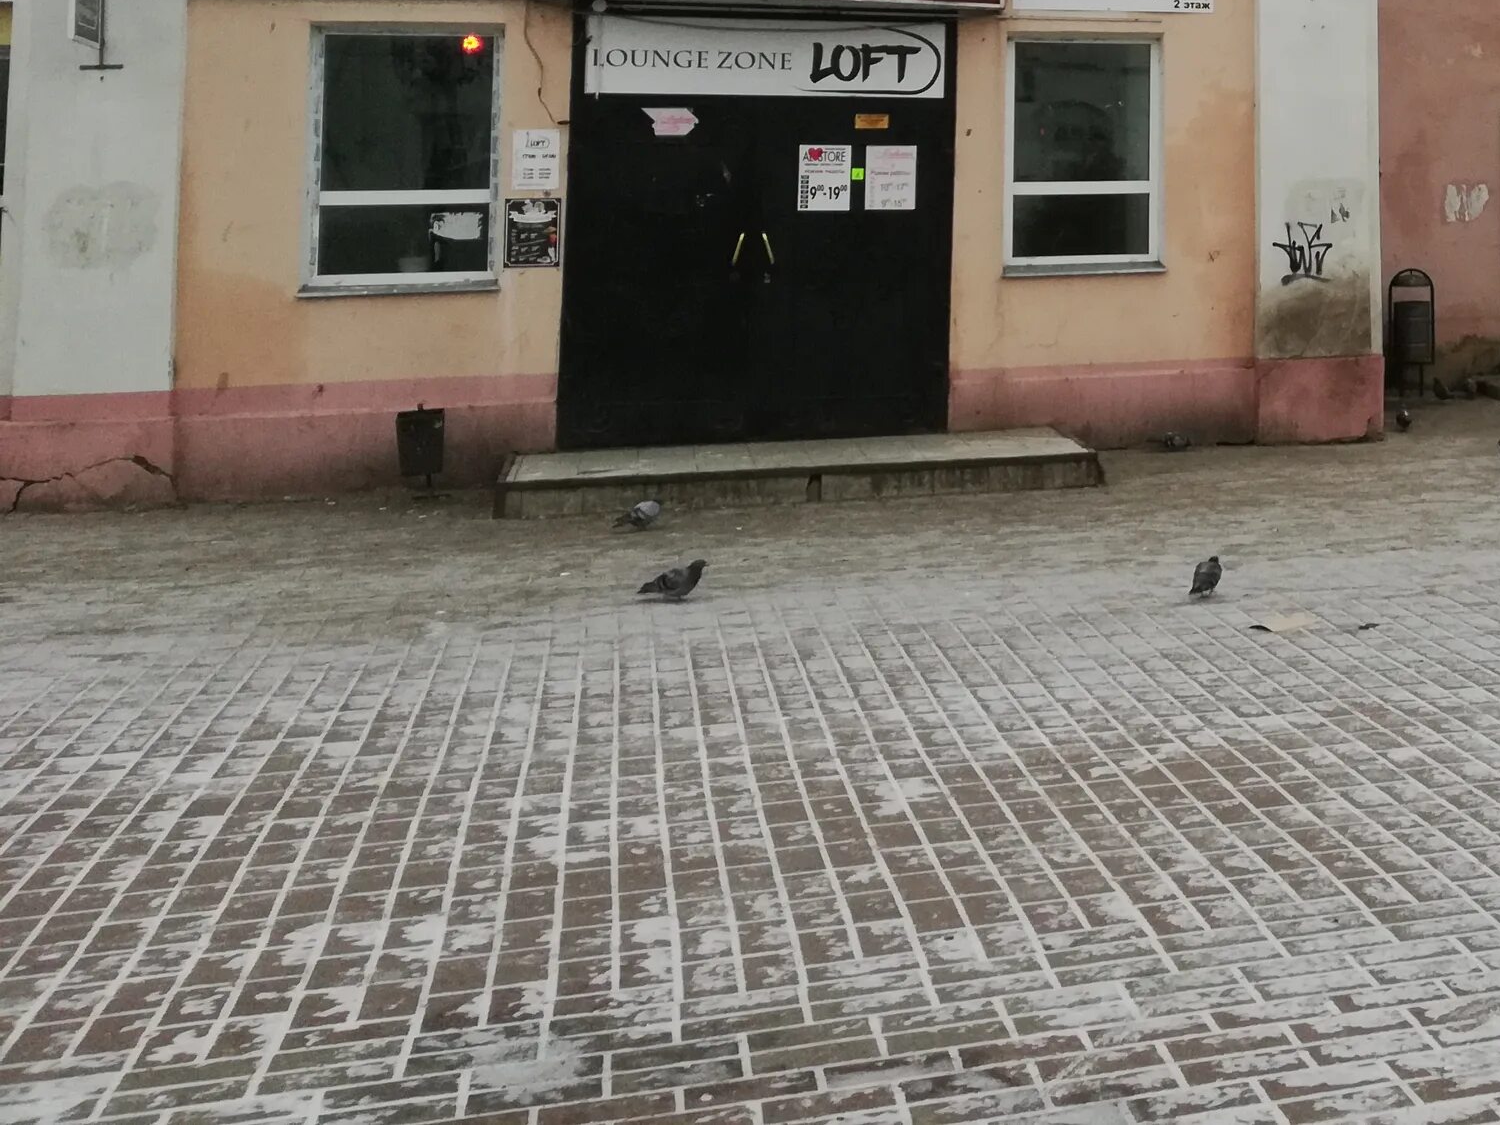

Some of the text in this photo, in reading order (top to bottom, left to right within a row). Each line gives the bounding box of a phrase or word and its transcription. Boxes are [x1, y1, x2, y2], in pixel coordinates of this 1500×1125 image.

[1173, 0, 1210, 10] 2 этаж
[592, 41, 922, 84] LOUNGE ZONE LOFT
